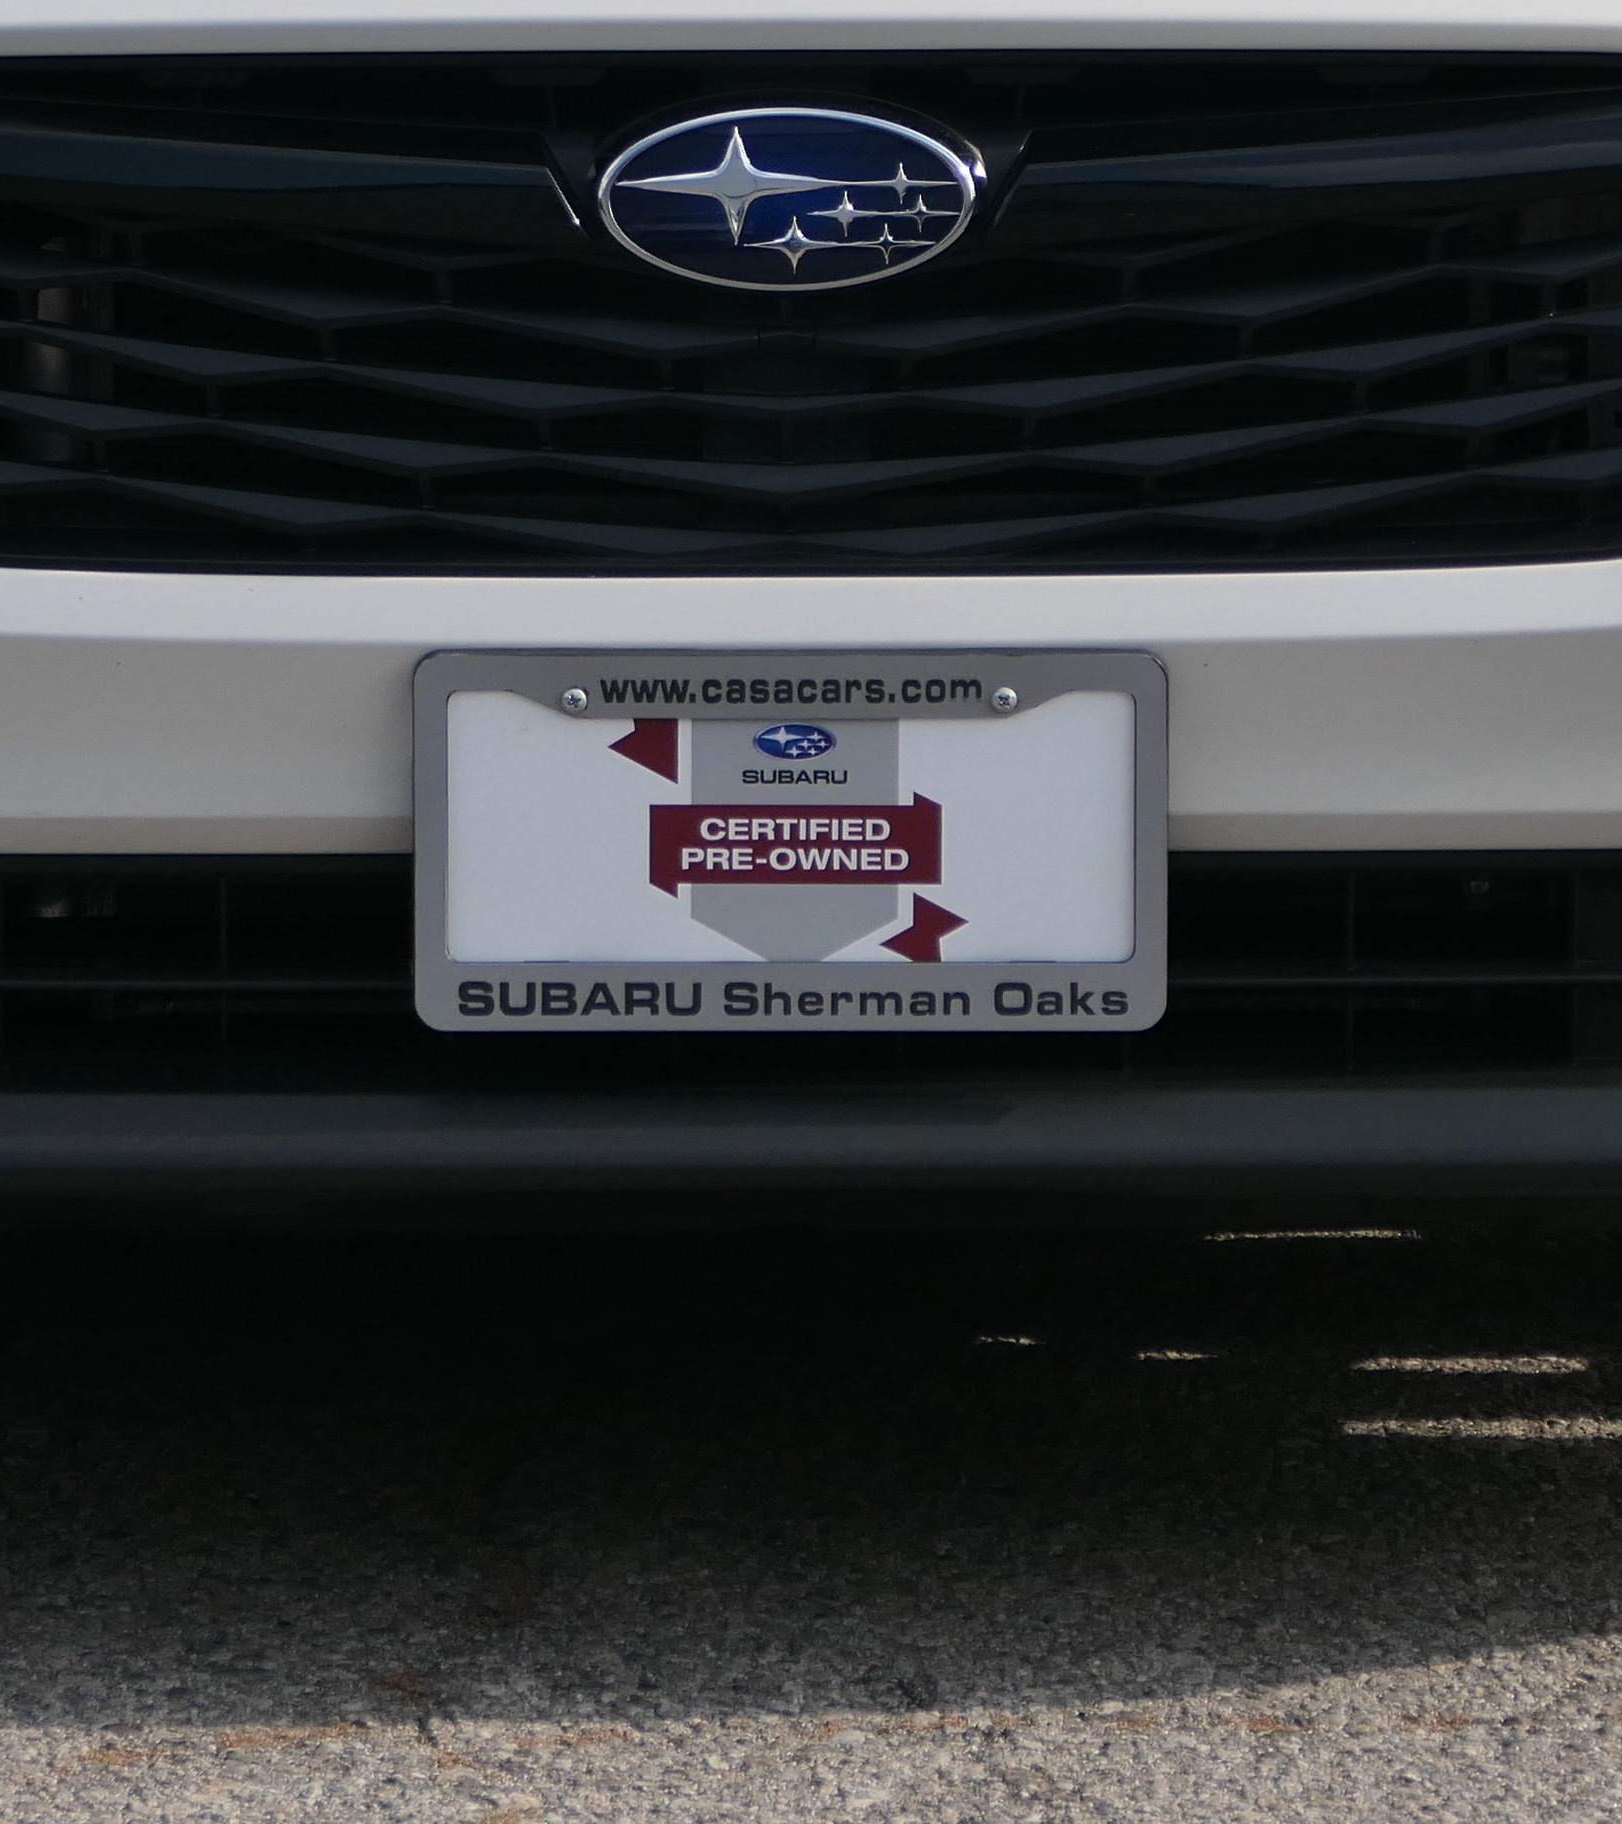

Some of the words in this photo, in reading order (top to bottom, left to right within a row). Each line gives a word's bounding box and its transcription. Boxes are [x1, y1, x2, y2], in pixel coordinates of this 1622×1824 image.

[600, 675, 983, 706] www.casacars.com
[742, 770, 848, 785] SUBARU
[699, 817, 892, 842] CERTIFIED
[681, 847, 910, 873] PRE-OWNED
[457, 982, 704, 1018] SUBARU
[723, 982, 971, 1017] Sherman
[993, 982, 1130, 1017] Oaks
